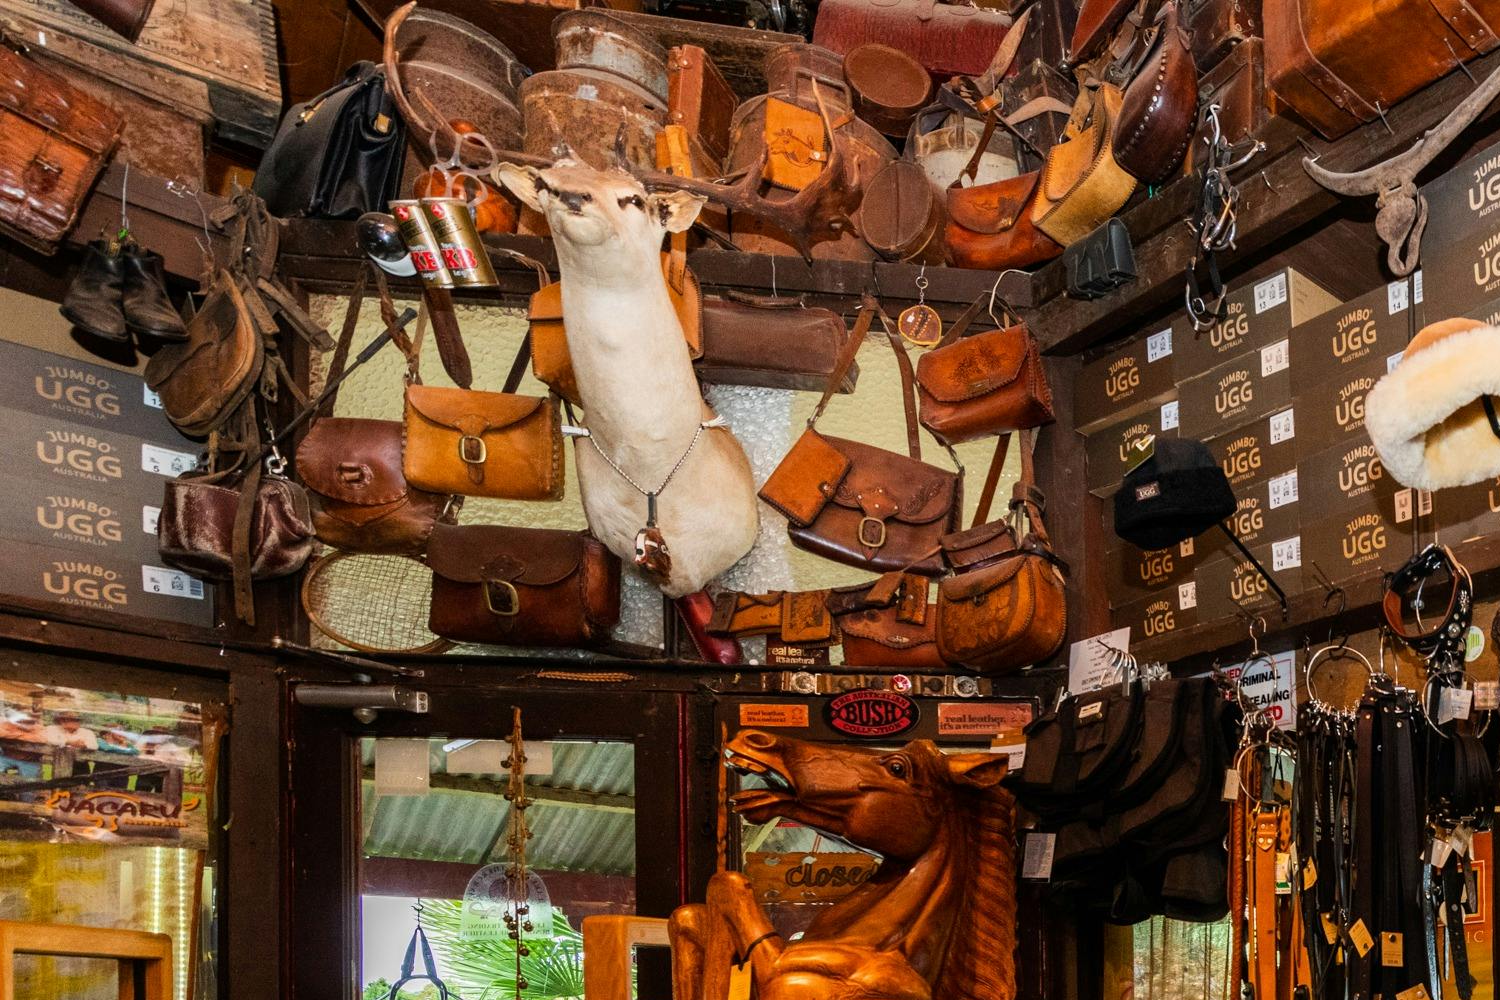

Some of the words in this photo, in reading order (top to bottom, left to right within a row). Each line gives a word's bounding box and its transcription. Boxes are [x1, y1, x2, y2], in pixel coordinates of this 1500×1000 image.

[1209, 312, 1249, 347] UGG
[1337, 308, 1370, 333] JUMBO
[1218, 339, 1243, 352] AUSTRALIA
[1332, 320, 1377, 358] UGG
[1109, 356, 1134, 376] JUMBO
[1342, 348, 1370, 364] AUSTRALIA
[46, 366, 110, 390] JUMBO
[1105, 366, 1140, 397] UGG
[1218, 371, 1247, 391] JUMBO
[1339, 377, 1372, 401] JUMBO
[35, 376, 121, 416] UGG
[1215, 381, 1253, 413] UGG
[52, 402, 106, 420] AUSTRALIA
[1222, 405, 1247, 419] AUSTRALIA
[1335, 395, 1366, 425] UG
[46, 431, 110, 453] JUMBO
[1122, 424, 1148, 442] JUMBO
[1227, 437, 1254, 456] JUMBO
[1342, 445, 1375, 468] JUMBO
[37, 441, 122, 478] UGG
[1223, 447, 1262, 478] UGG
[53, 466, 107, 483] AUSTRALIA
[1339, 457, 1383, 492] UGG
[1139, 487, 1156, 498] UGG
[1348, 483, 1376, 498] AUSTRALIA
[46, 496, 111, 517] JUMBO
[37, 506, 122, 542] UGG
[1227, 508, 1264, 537] UGG
[1346, 514, 1379, 535] JUMBO
[53, 531, 108, 546] AUSTRALIA
[1342, 526, 1386, 559] UGG
[1140, 555, 1174, 580] UGG
[1352, 552, 1380, 566] AUSTRALIA
[52, 561, 117, 581] JUMBO
[43, 572, 128, 605] UGG
[1230, 573, 1268, 600] UGG
[59, 596, 113, 610] AUSTRALIA
[1146, 600, 1170, 618] JUMBO
[1144, 612, 1175, 637] UGG
[1248, 689, 1289, 706] TEALING
[844, 700, 898, 726] BUSH
[58, 799, 182, 819] JACARU
